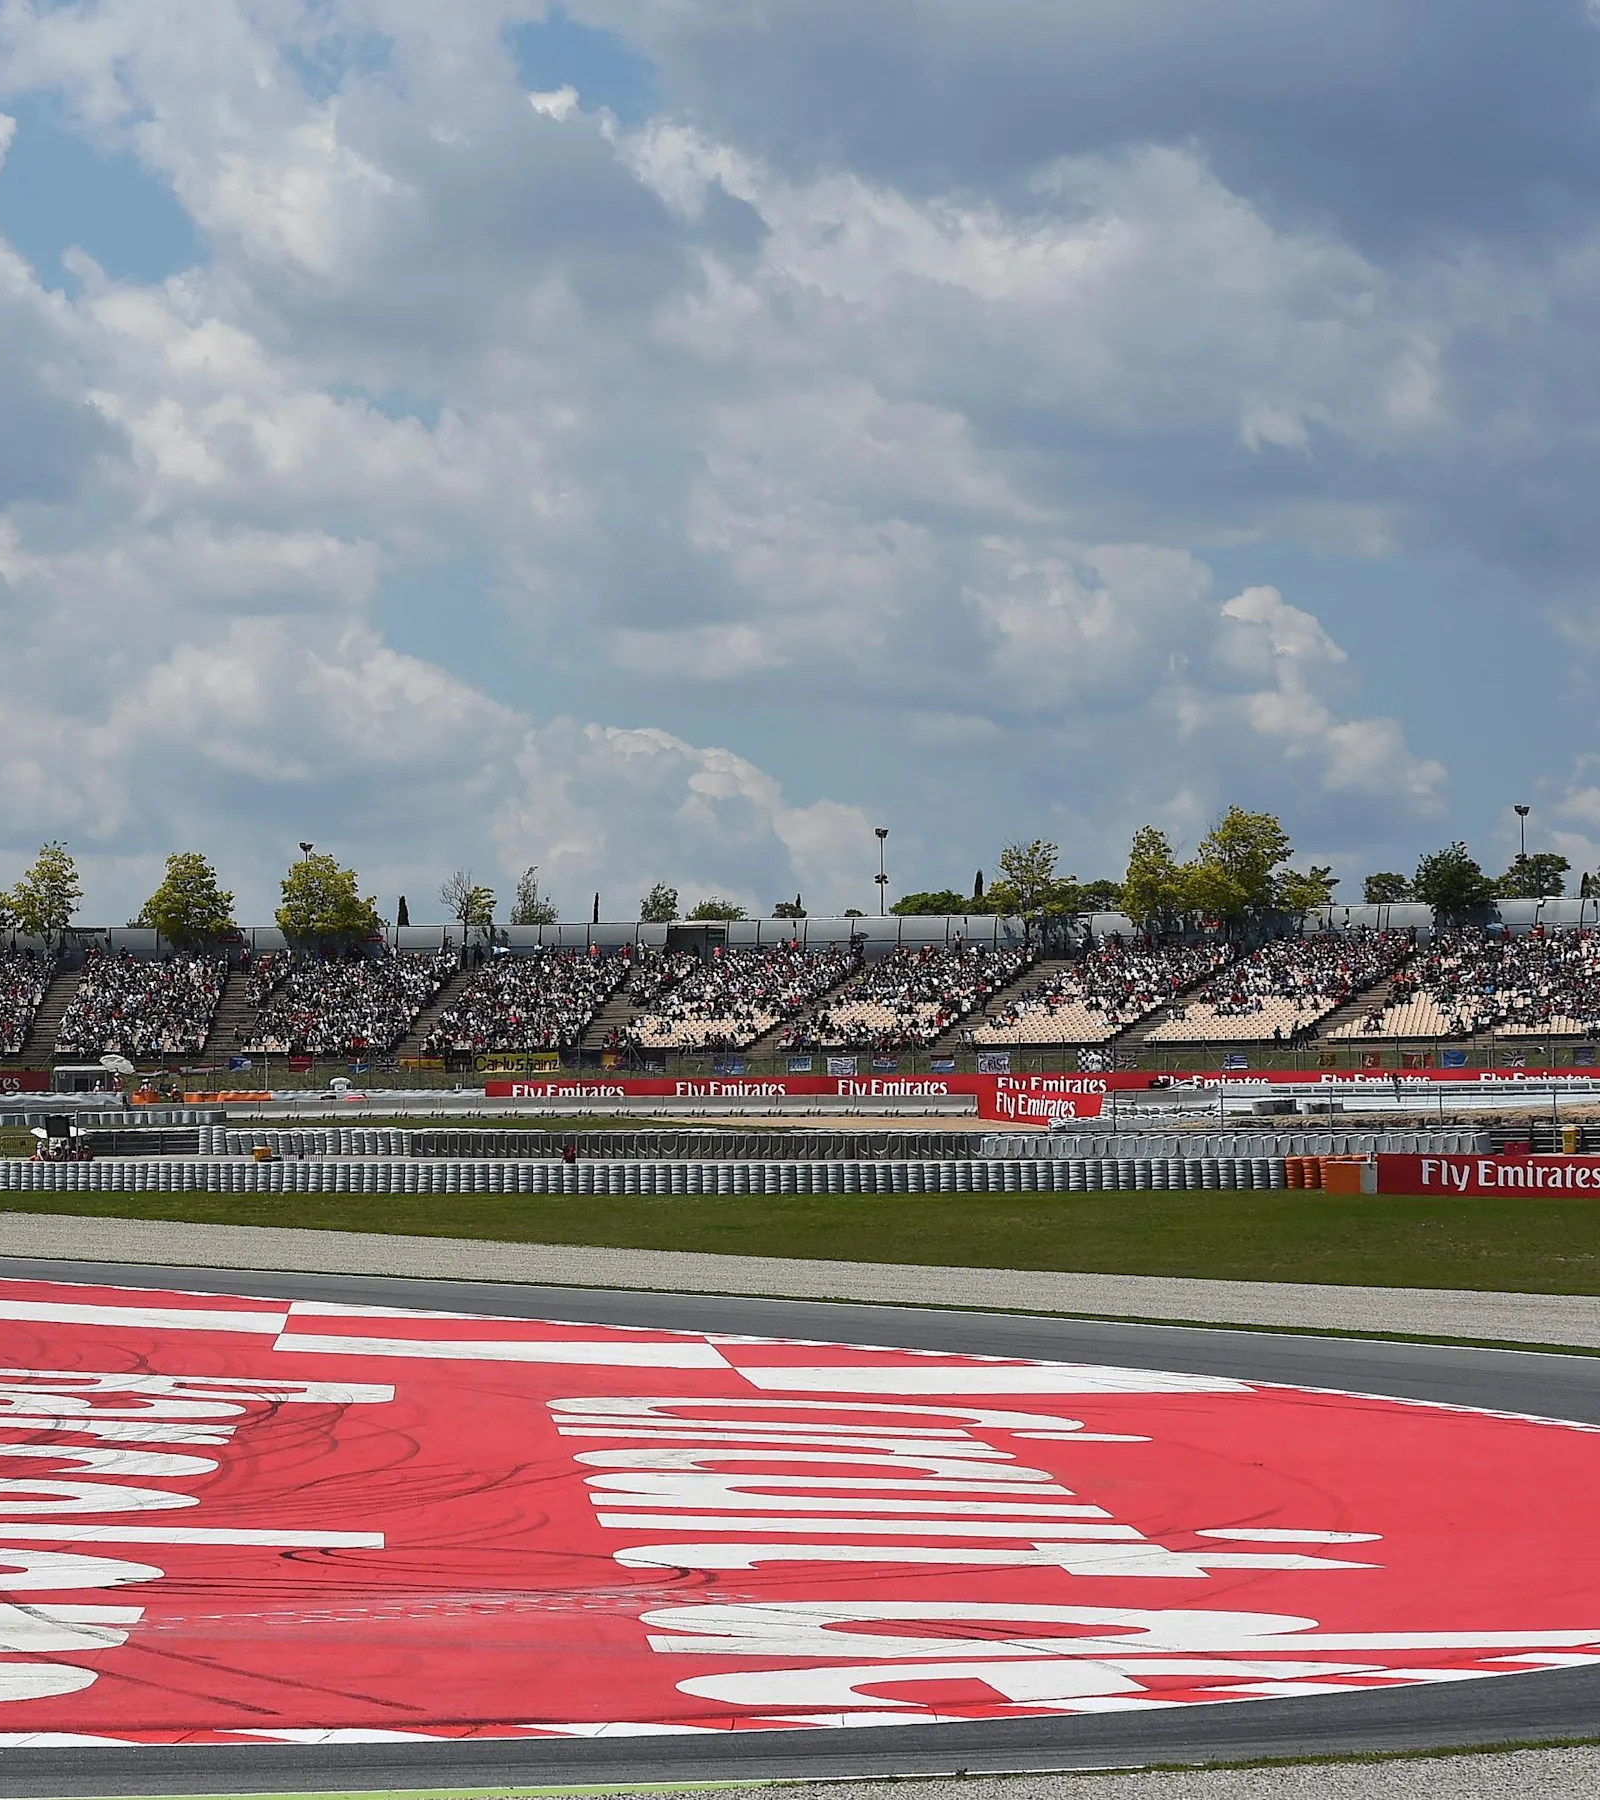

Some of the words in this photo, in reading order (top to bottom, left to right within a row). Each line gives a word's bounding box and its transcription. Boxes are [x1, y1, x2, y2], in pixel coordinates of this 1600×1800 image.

[546, 1082, 624, 1097] Emirates
[676, 1081, 706, 1096] Fly
[708, 1080, 786, 1096] Emirates
[838, 1079, 866, 1095] Fly
[871, 1078, 948, 1095] Emirates
[1031, 1075, 1107, 1093] Emirates
[995, 1091, 1015, 1119] Fly
[1017, 1093, 1076, 1118] Emirates
[1421, 1159, 1471, 1191] Fly
[1477, 1158, 1600, 1189] Emirates
[546, 1396, 1385, 1578] Circuit
[638, 1601, 1600, 1708] de
